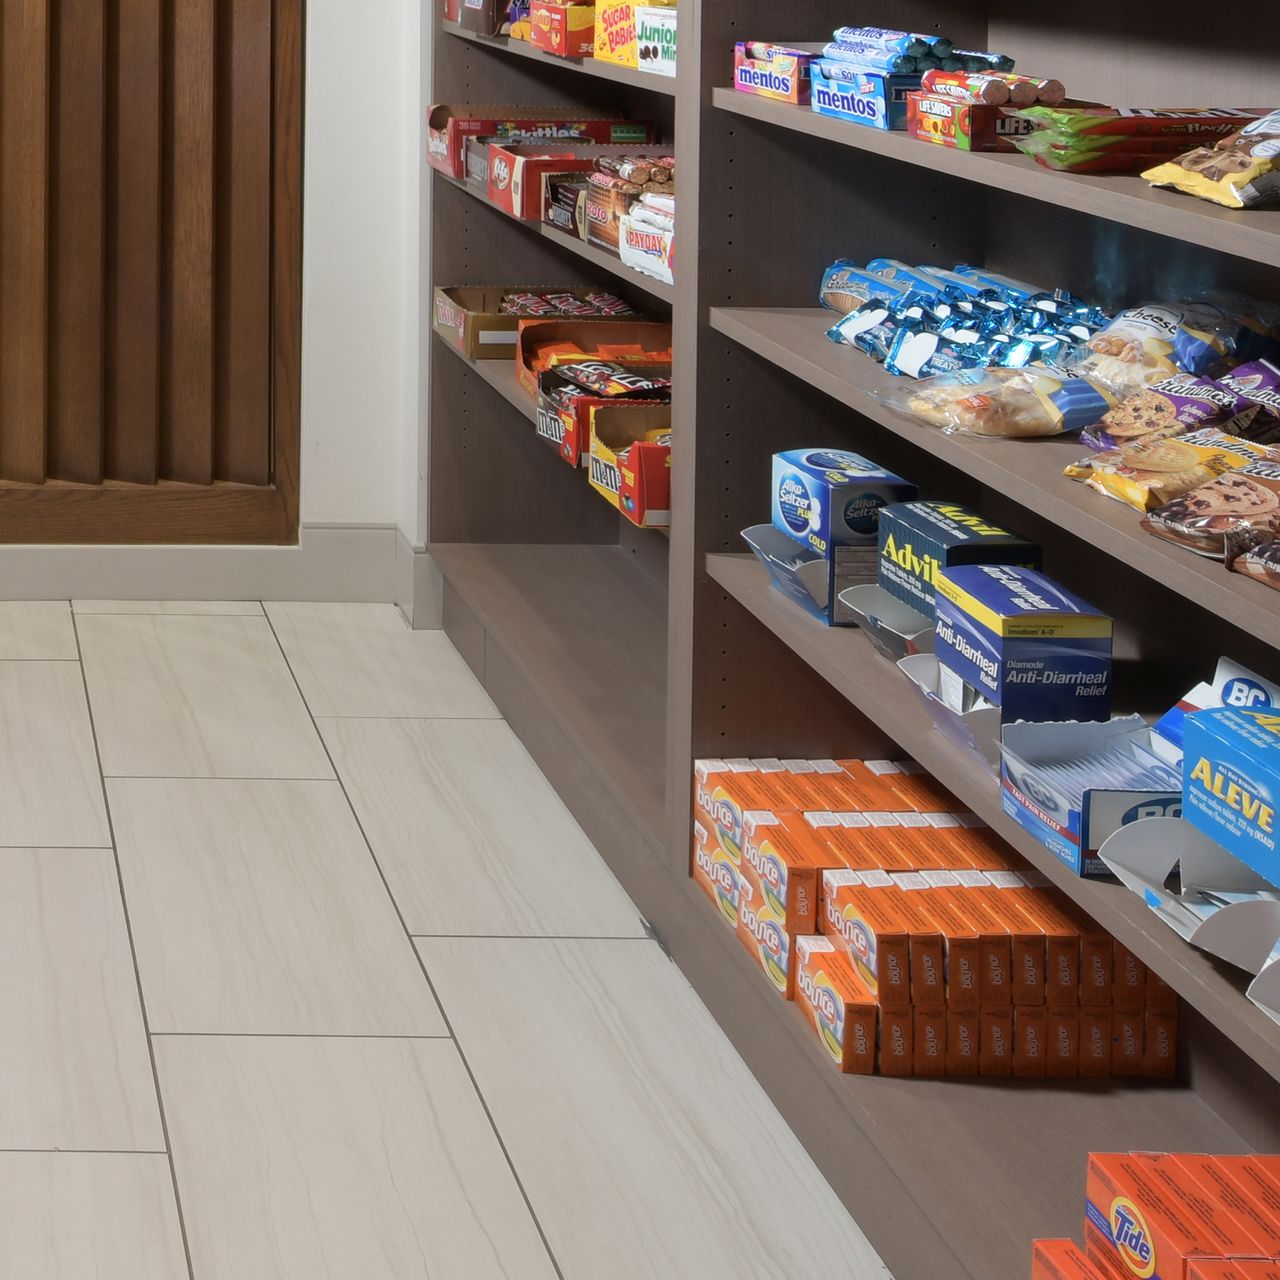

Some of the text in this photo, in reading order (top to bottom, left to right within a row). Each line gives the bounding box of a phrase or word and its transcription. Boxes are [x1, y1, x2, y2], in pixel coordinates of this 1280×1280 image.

[601, 5, 632, 27] SUGAR
[739, 66, 790, 93] mentos
[816, 89, 877, 119] mentos
[628, 229, 663, 251] PAYDAY
[780, 490, 809, 509] Seltzer
[782, 479, 804, 495] Alka-
[849, 499, 880, 509] Alka-
[808, 534, 826, 551] COLD
[882, 533, 941, 585] Advil
[936, 620, 998, 679] Anti-Diarrheal
[1006, 661, 1044, 669] Diamode
[1006, 671, 1108, 685] Anti-Diarrheal
[980, 670, 998, 692] Relief
[1075, 685, 1108, 696] Relief
[1218, 764, 1227, 775] ALL
[1228, 770, 1239, 782] DAY
[697, 782, 733, 832] bounce
[1012, 787, 1061, 832] FAST PAIN RELIEF
[1191, 757, 1275, 833] ALEVE
[696, 844, 733, 893] bounce
[743, 832, 779, 889] bounce
[741, 899, 780, 956] bounce
[826, 898, 868, 960] bounce
[797, 963, 836, 1023] bounce
[856, 1024, 867, 1055] bounce
[1113, 1206, 1151, 1263] Tide
